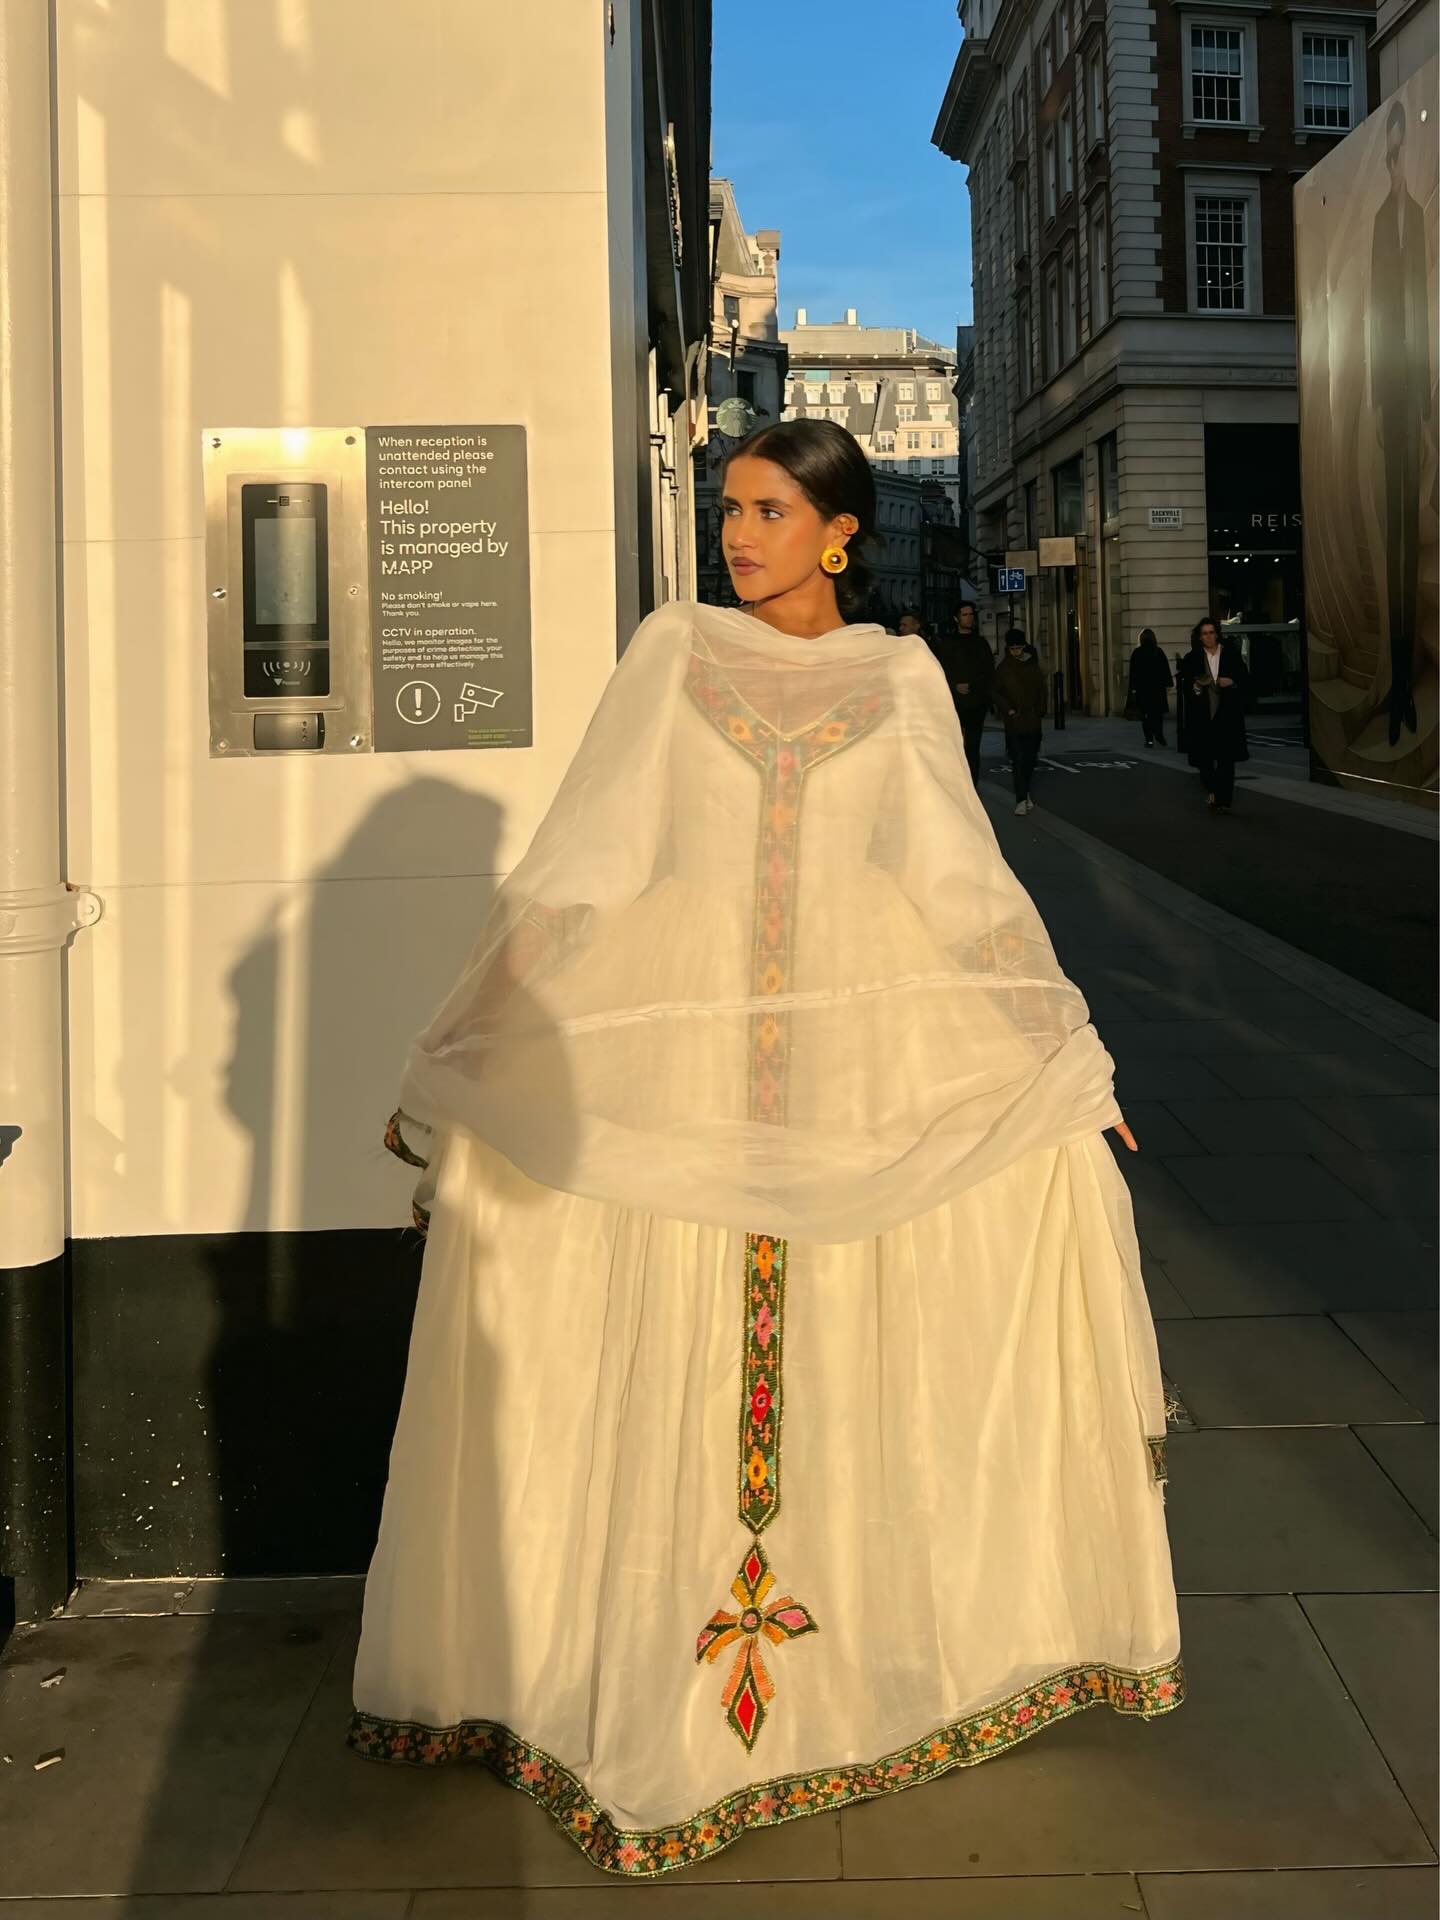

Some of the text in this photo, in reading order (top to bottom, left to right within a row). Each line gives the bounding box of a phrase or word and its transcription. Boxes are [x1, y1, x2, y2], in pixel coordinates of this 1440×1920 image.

[378, 436, 487, 448] When reception is
[379, 450, 494, 462] unattended please
[380, 464, 487, 476] contact using the
[380, 478, 471, 490] intercom panel
[381, 500, 429, 514] Hello!
[380, 520, 496, 538] This property
[381, 538, 508, 558] is managed by
[382, 560, 432, 575] MAPP
[382, 591, 442, 601] No smoking!
[425, 627, 477, 637] operation.
